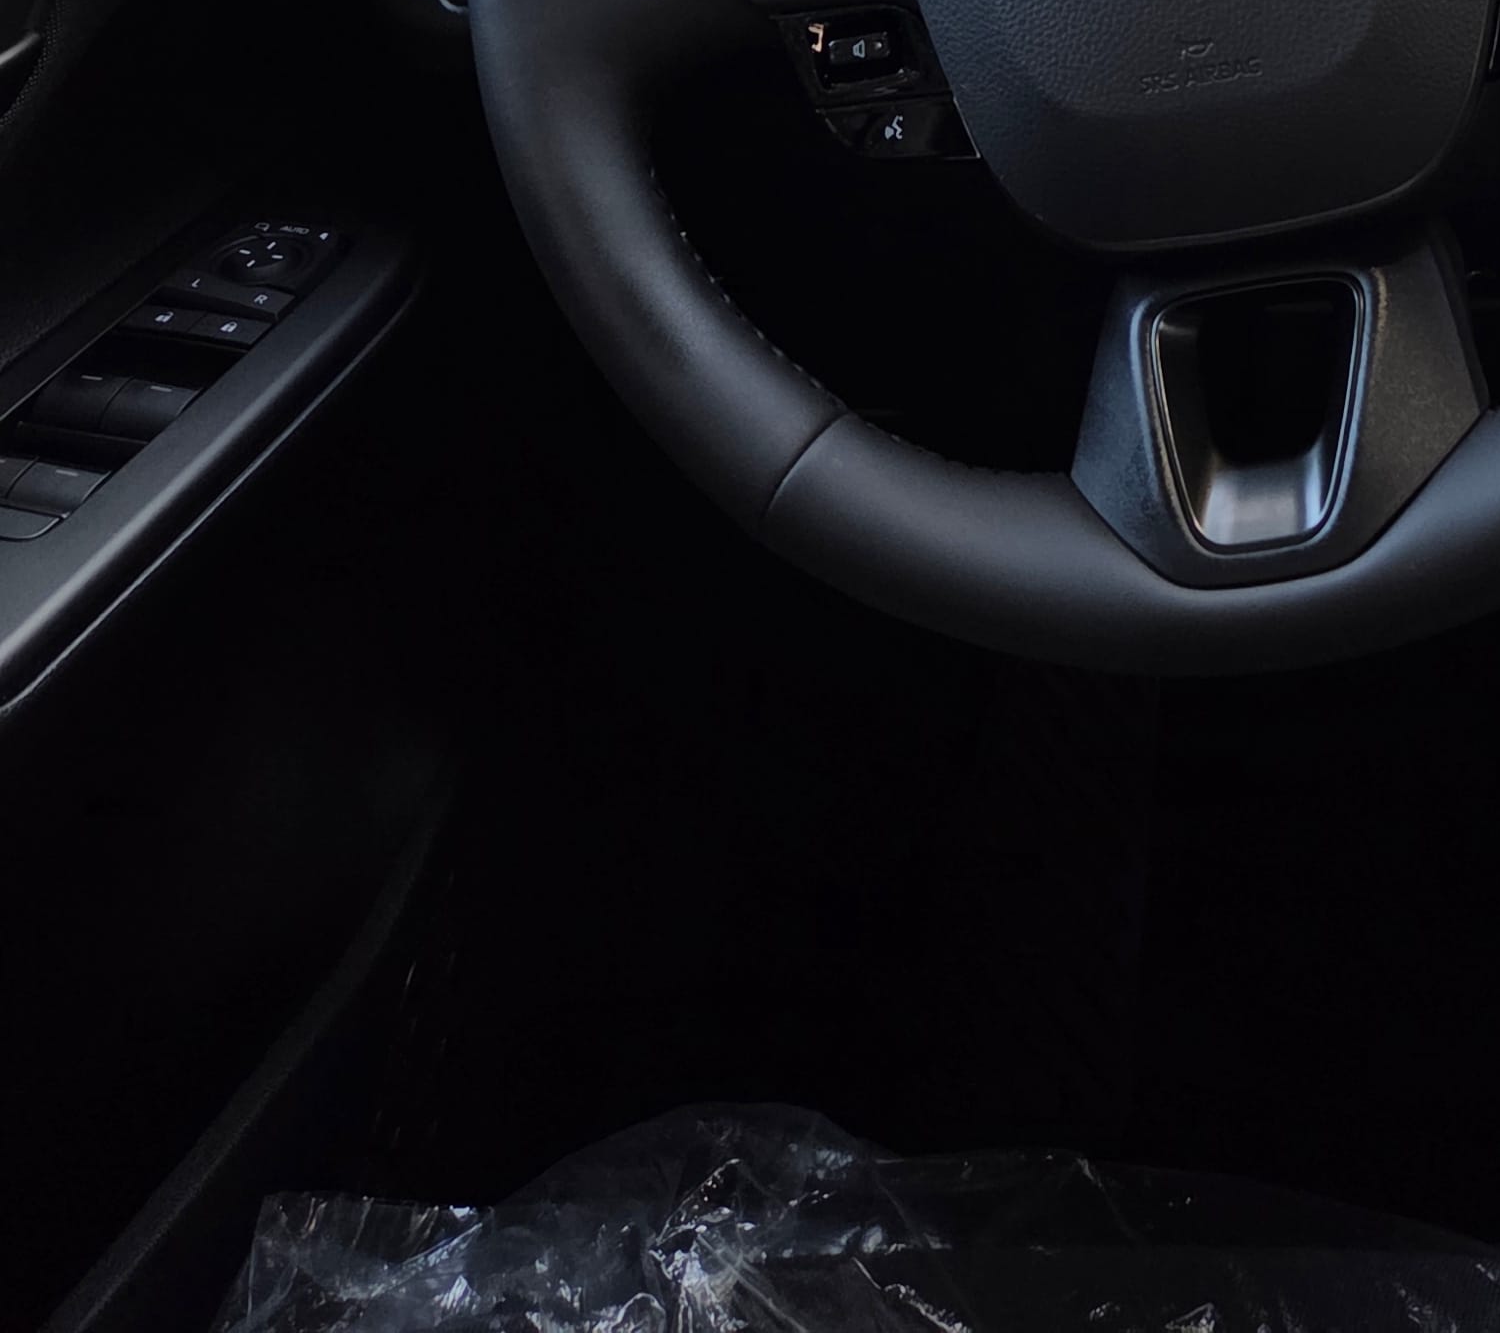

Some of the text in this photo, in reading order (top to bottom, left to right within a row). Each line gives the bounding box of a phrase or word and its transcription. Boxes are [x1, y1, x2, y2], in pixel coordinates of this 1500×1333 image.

[279, 225, 311, 235] AUTO
[191, 278, 201, 289] L
[253, 294, 269, 305] R
